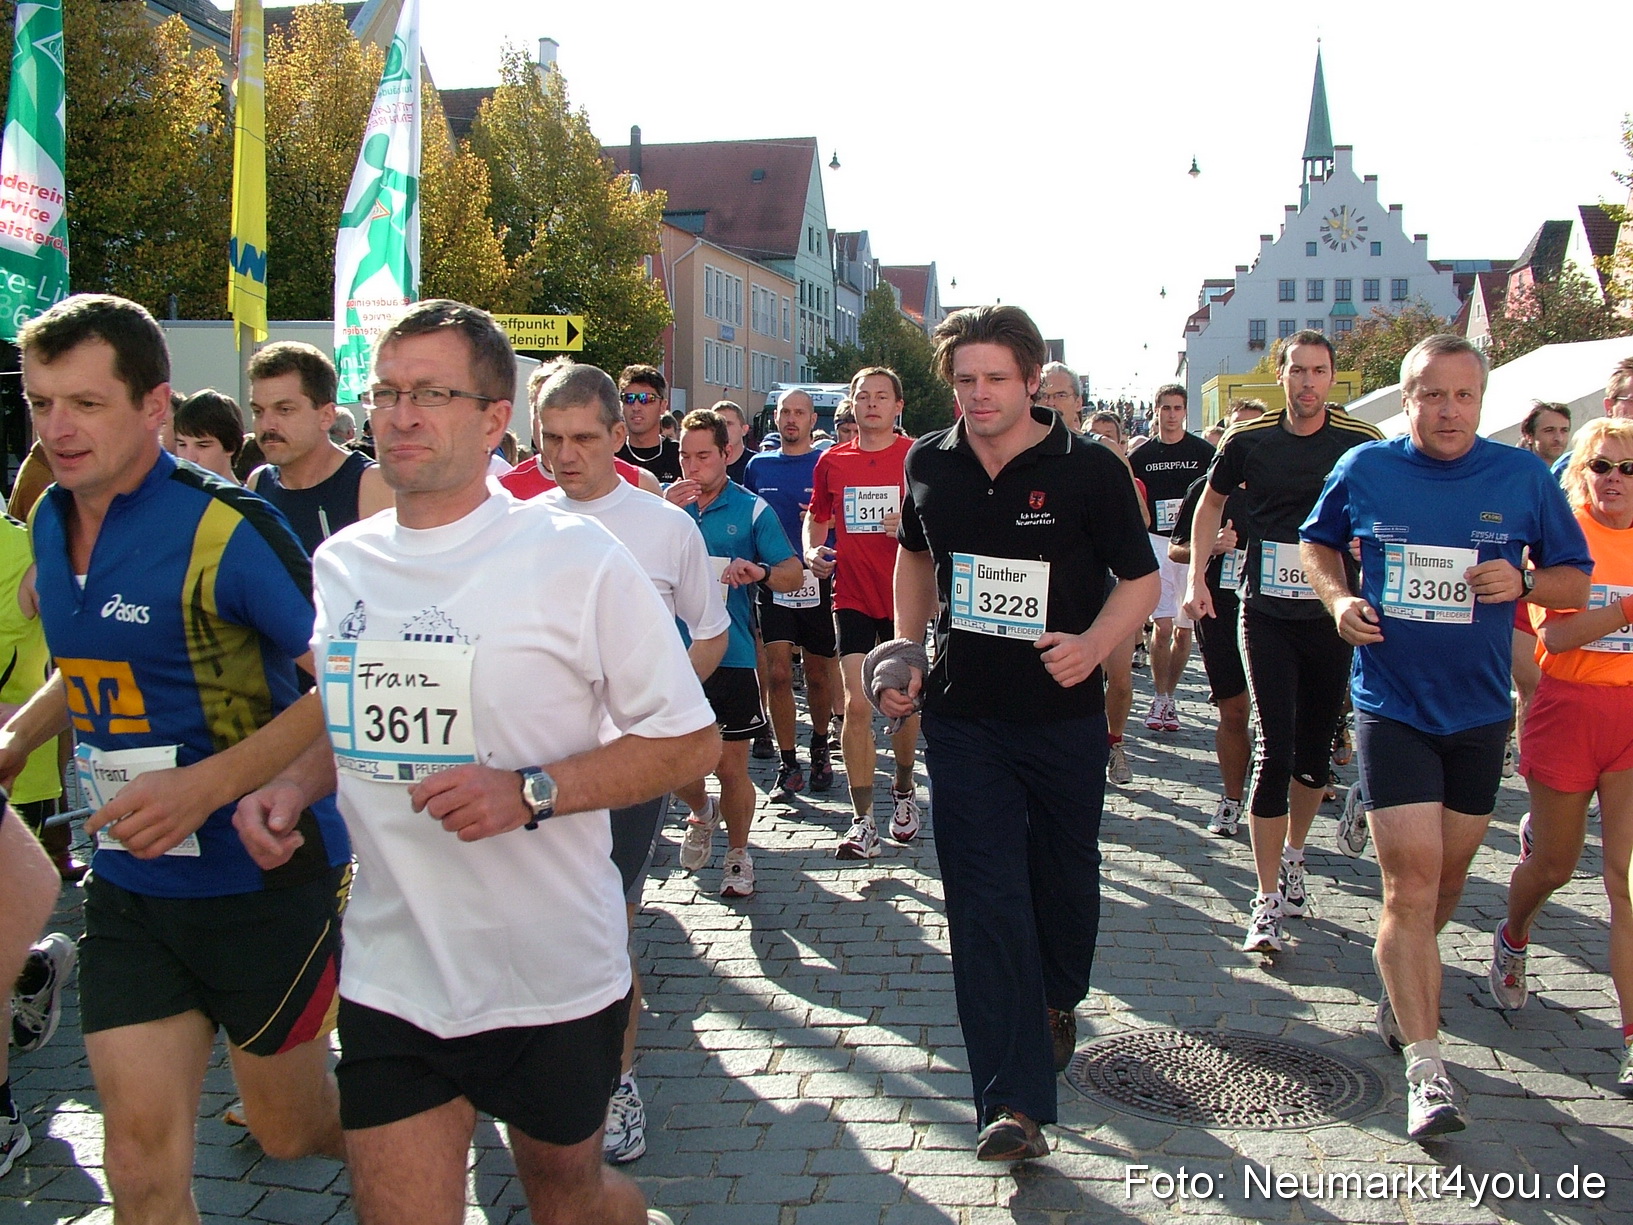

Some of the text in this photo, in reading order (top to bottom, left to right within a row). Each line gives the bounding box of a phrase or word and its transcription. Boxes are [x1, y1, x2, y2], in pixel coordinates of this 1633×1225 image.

[0, 266, 70, 303] ce-Li
[1145, 461, 1199, 472] OBERPFALZ
[858, 491, 888, 500] Andreas
[1407, 552, 1454, 569] Thomas
[978, 564, 1027, 583] Günther
[956, 583, 962, 594] D
[1408, 578, 1468, 603] 3308
[978, 592, 1039, 618] 3228
[358, 662, 441, 690] Franz
[364, 704, 458, 745] 3617
